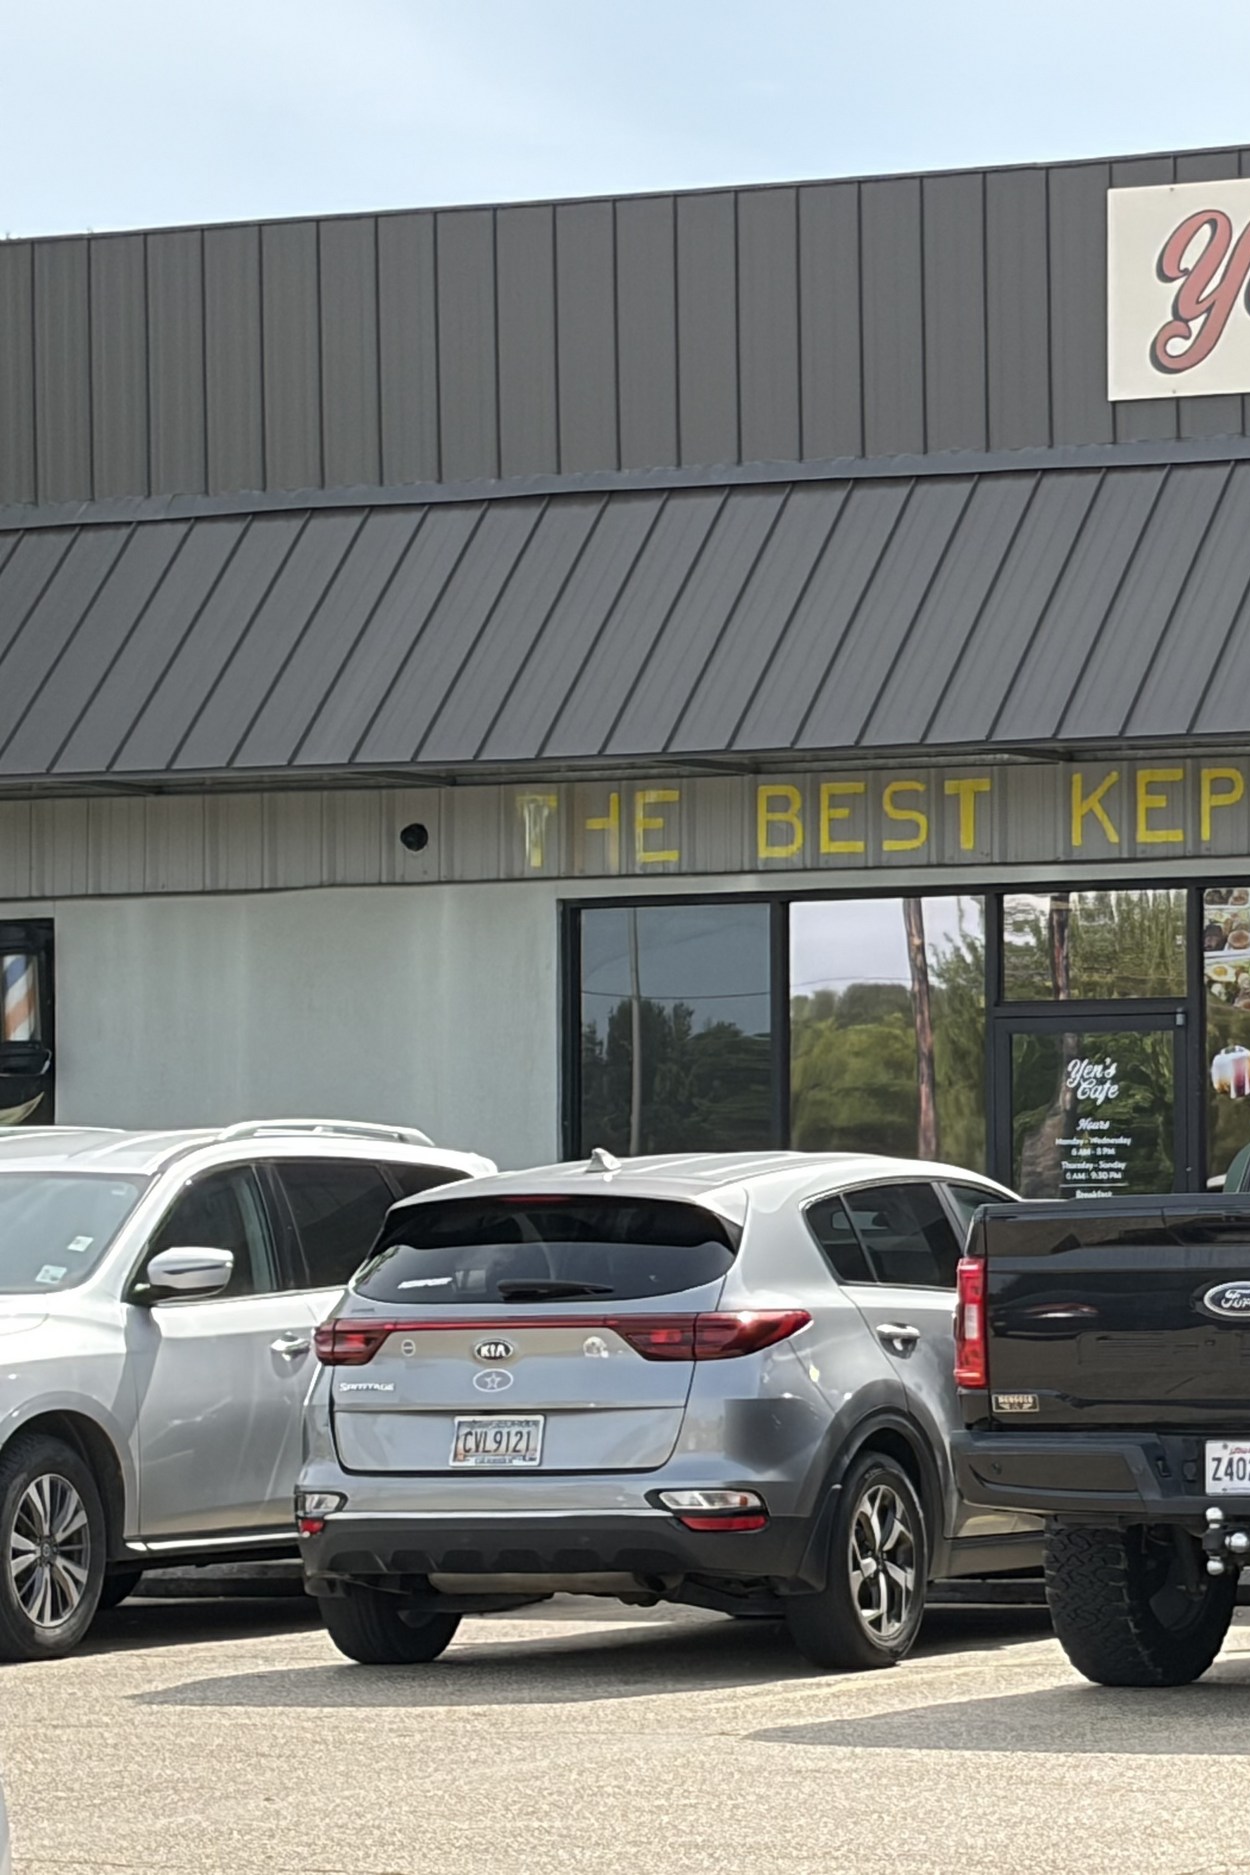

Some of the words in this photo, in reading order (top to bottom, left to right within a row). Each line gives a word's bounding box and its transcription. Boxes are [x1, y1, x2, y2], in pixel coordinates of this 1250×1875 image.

[757, 778, 990, 859] BEST
[1066, 1057, 1117, 1088] Yen's
[1077, 1078, 1119, 1106] Cafe
[1076, 1117, 1110, 1131] Hours
[480, 1343, 507, 1357] KIA
[463, 1430, 532, 1453] CVL9121
